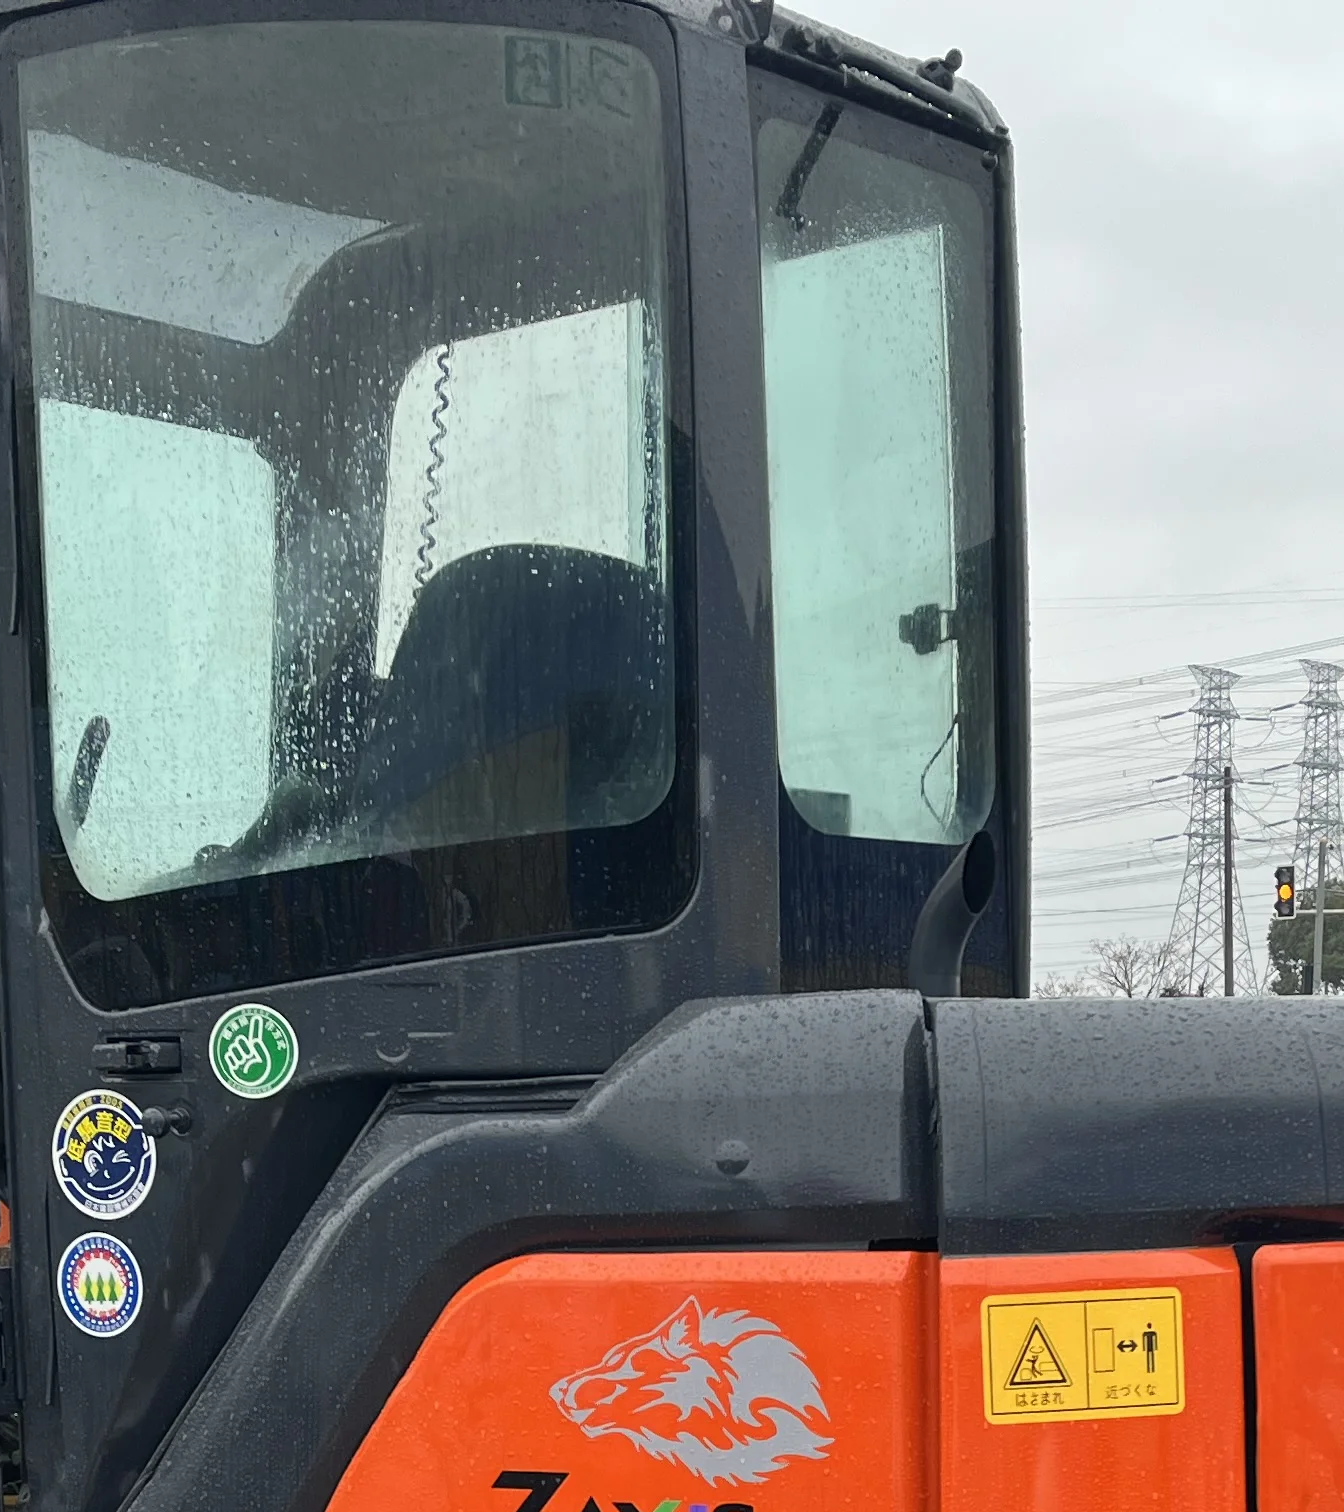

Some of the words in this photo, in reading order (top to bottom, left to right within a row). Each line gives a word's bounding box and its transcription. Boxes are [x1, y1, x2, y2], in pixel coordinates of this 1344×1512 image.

[1015, 1391, 1065, 1408] はさまれ
[1105, 1383, 1157, 1400] 近づくな
